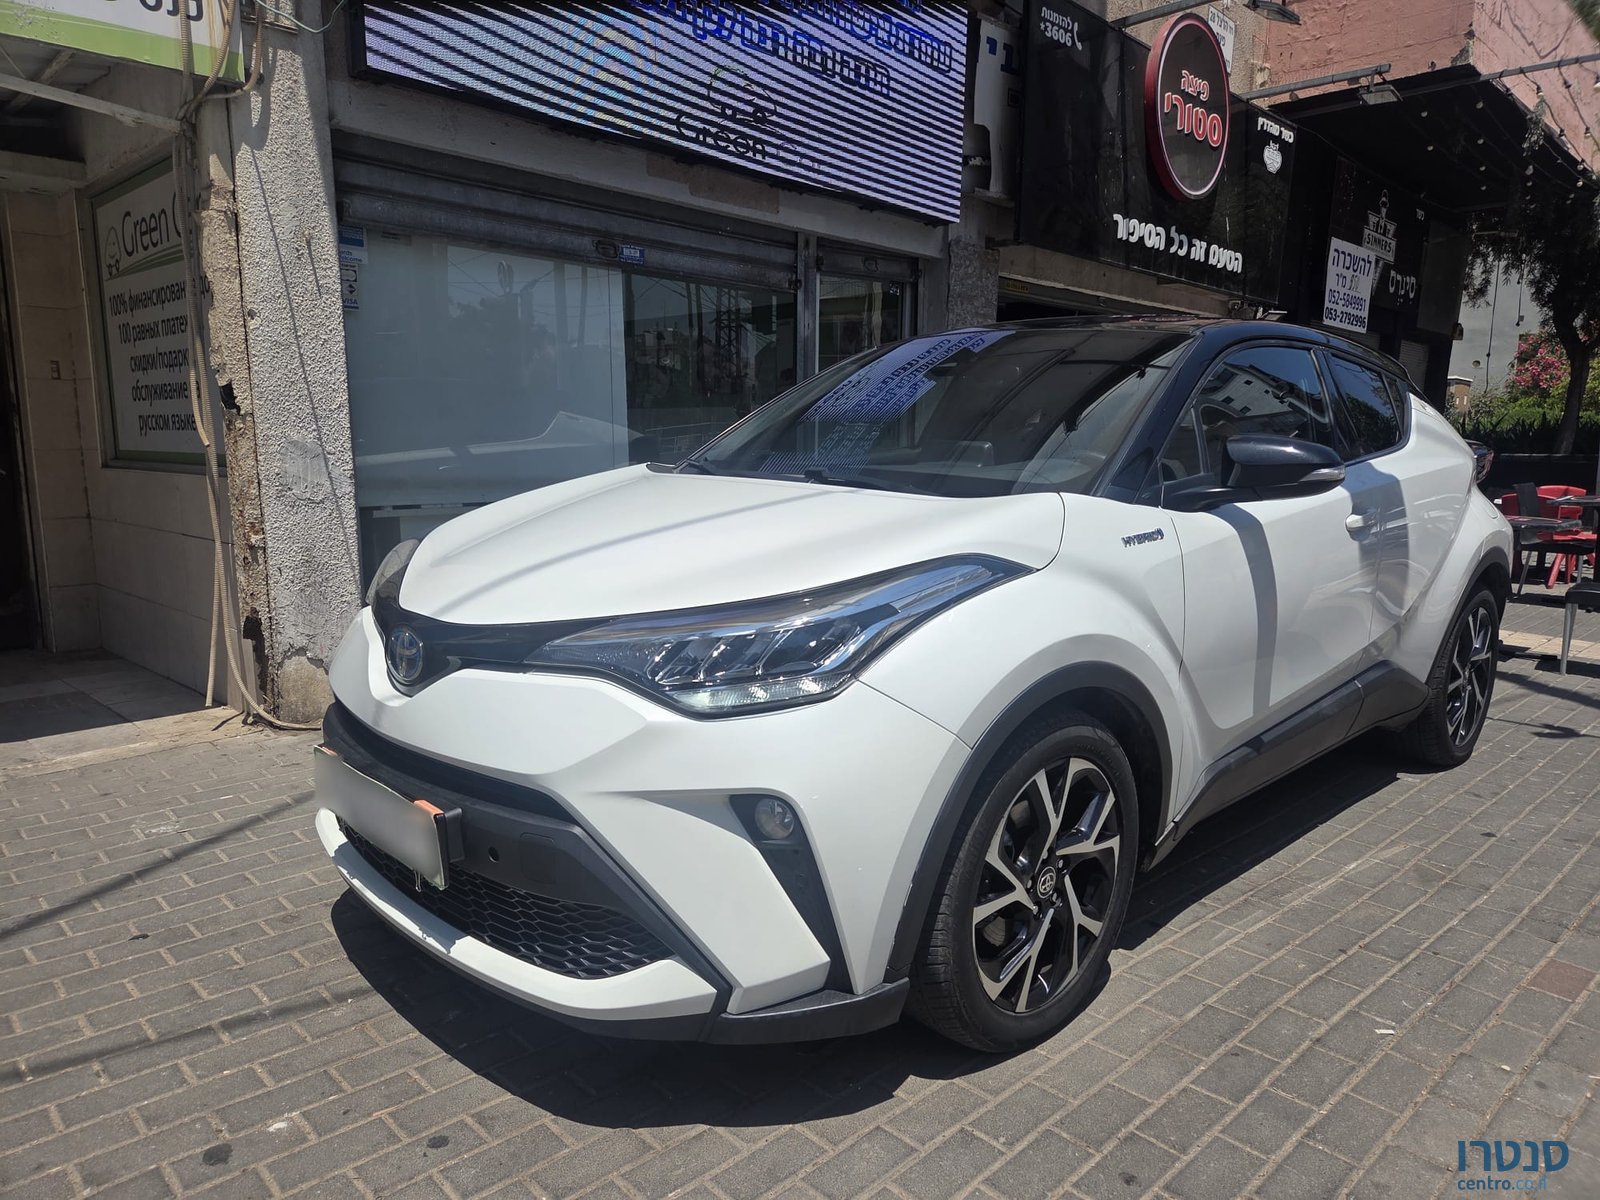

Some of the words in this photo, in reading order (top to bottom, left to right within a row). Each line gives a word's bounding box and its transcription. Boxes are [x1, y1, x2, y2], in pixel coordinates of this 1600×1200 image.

[1040, 6, 1072, 30] להזמנות
[1180, 69, 1209, 102] פיצה
[1164, 91, 1223, 147] סטורי
[1257, 116, 1280, 136] מהדרין
[674, 113, 766, 160] Green
[1280, 127, 1294, 143] כשר
[121, 208, 170, 257] Green
[1112, 213, 1166, 251] הסיפור
[1169, 225, 1188, 257] כל
[1366, 233, 1393, 253] SINNERS
[1190, 238, 1207, 263] זה
[1331, 246, 1373, 278] להשכרה
[109, 293, 128, 317] 100%
[1324, 306, 1367, 330] 053-2792996
[118, 321, 132, 345] 100
[132, 320, 161, 348] равных
[132, 379, 189, 407] обслуживание
[138, 414, 171, 436] русском
[171, 413, 197, 431] языке
